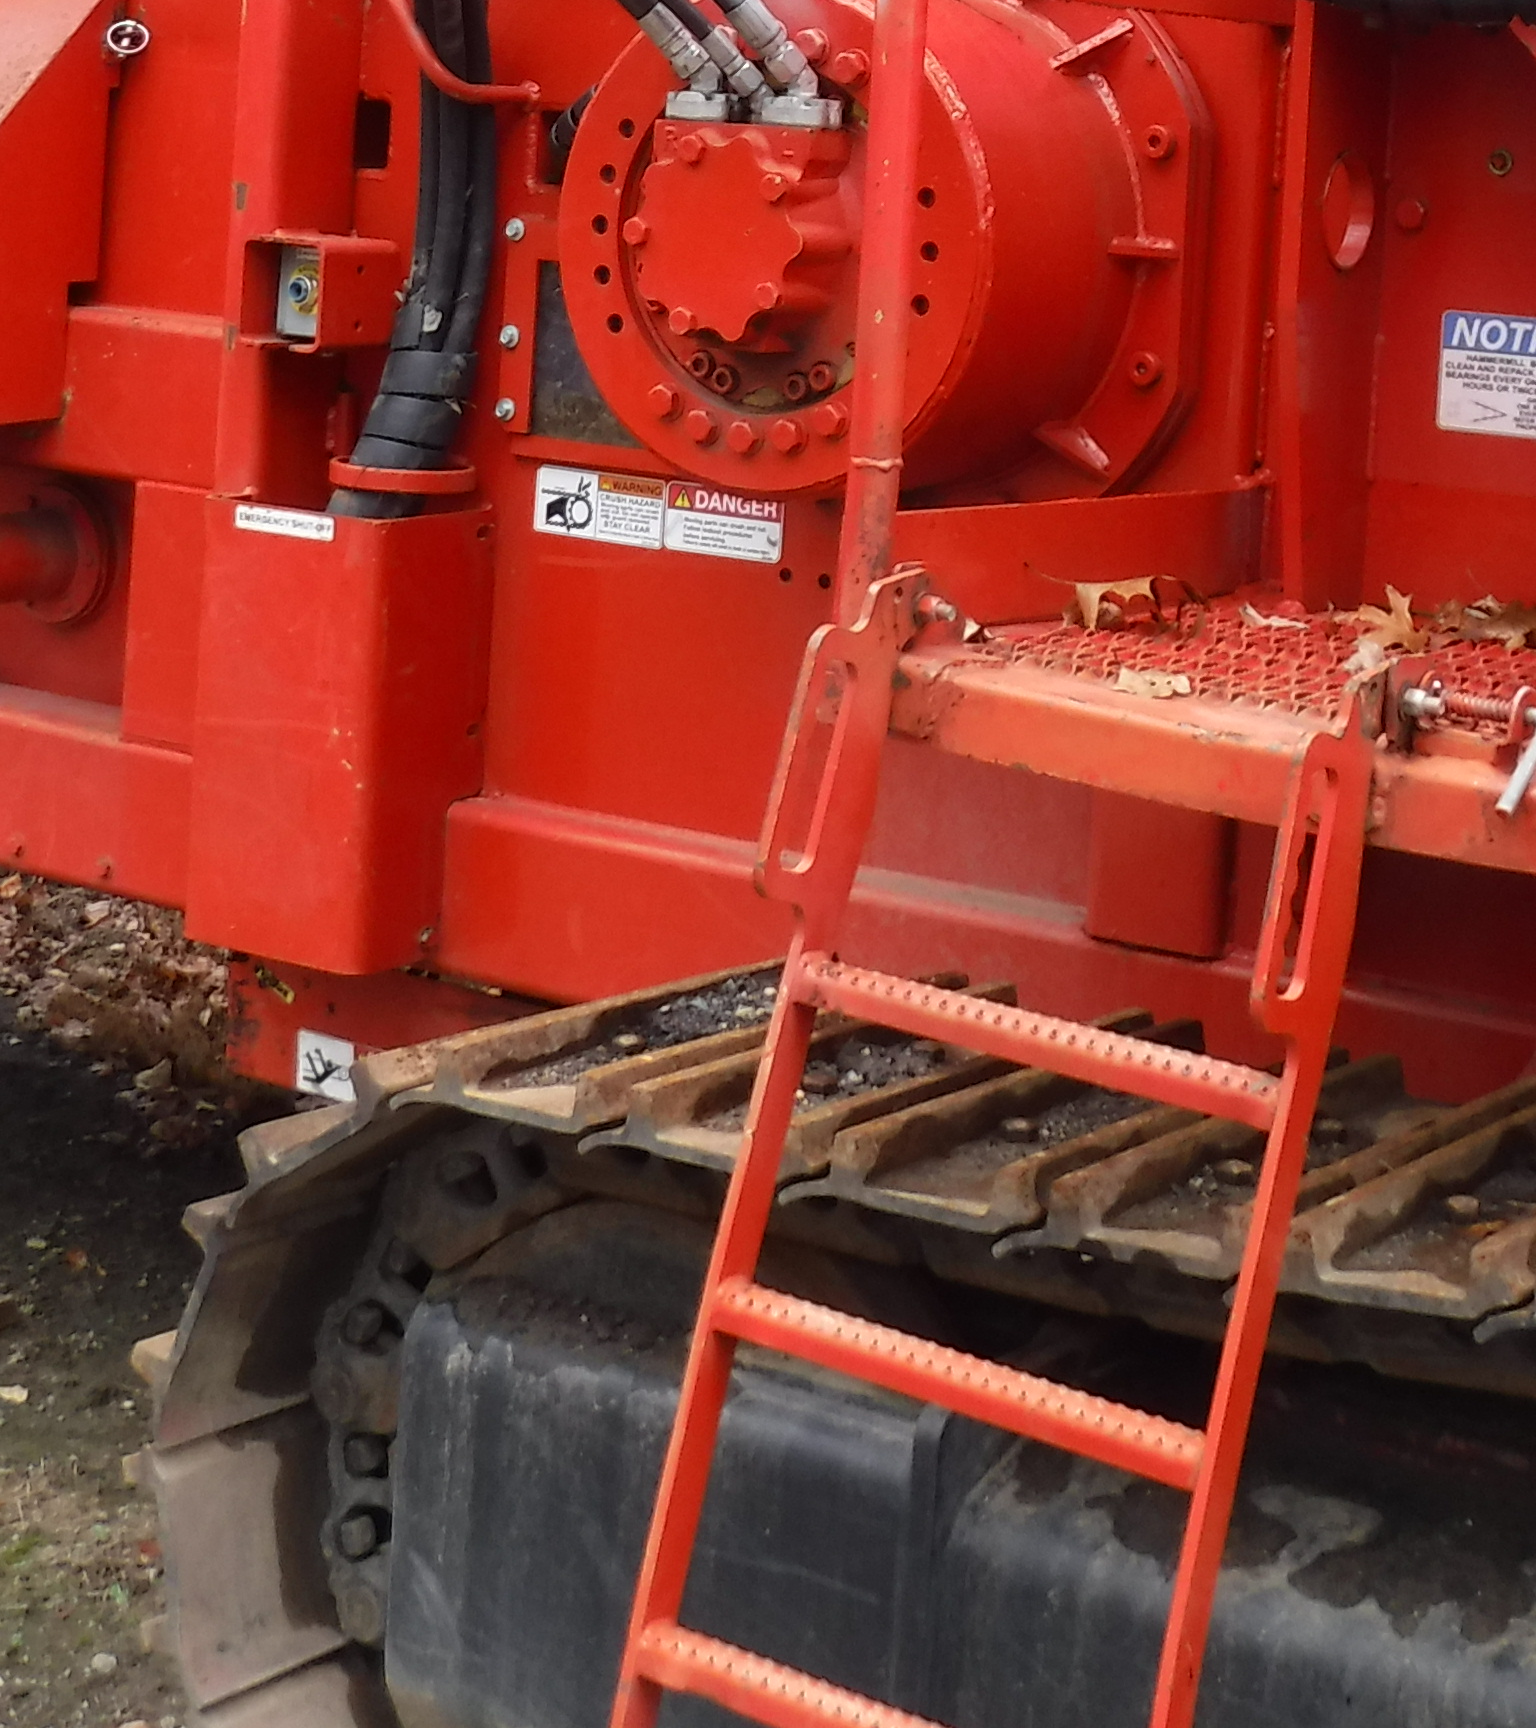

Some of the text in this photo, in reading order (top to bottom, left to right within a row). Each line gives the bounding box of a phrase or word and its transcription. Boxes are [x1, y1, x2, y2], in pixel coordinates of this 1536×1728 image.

[1445, 360, 1475, 371] CLEAN
[1477, 364, 1495, 373] AND
[612, 481, 662, 497] WARNING
[599, 493, 661, 509] CRUSH HAZARD
[694, 489, 778, 519] DANGER
